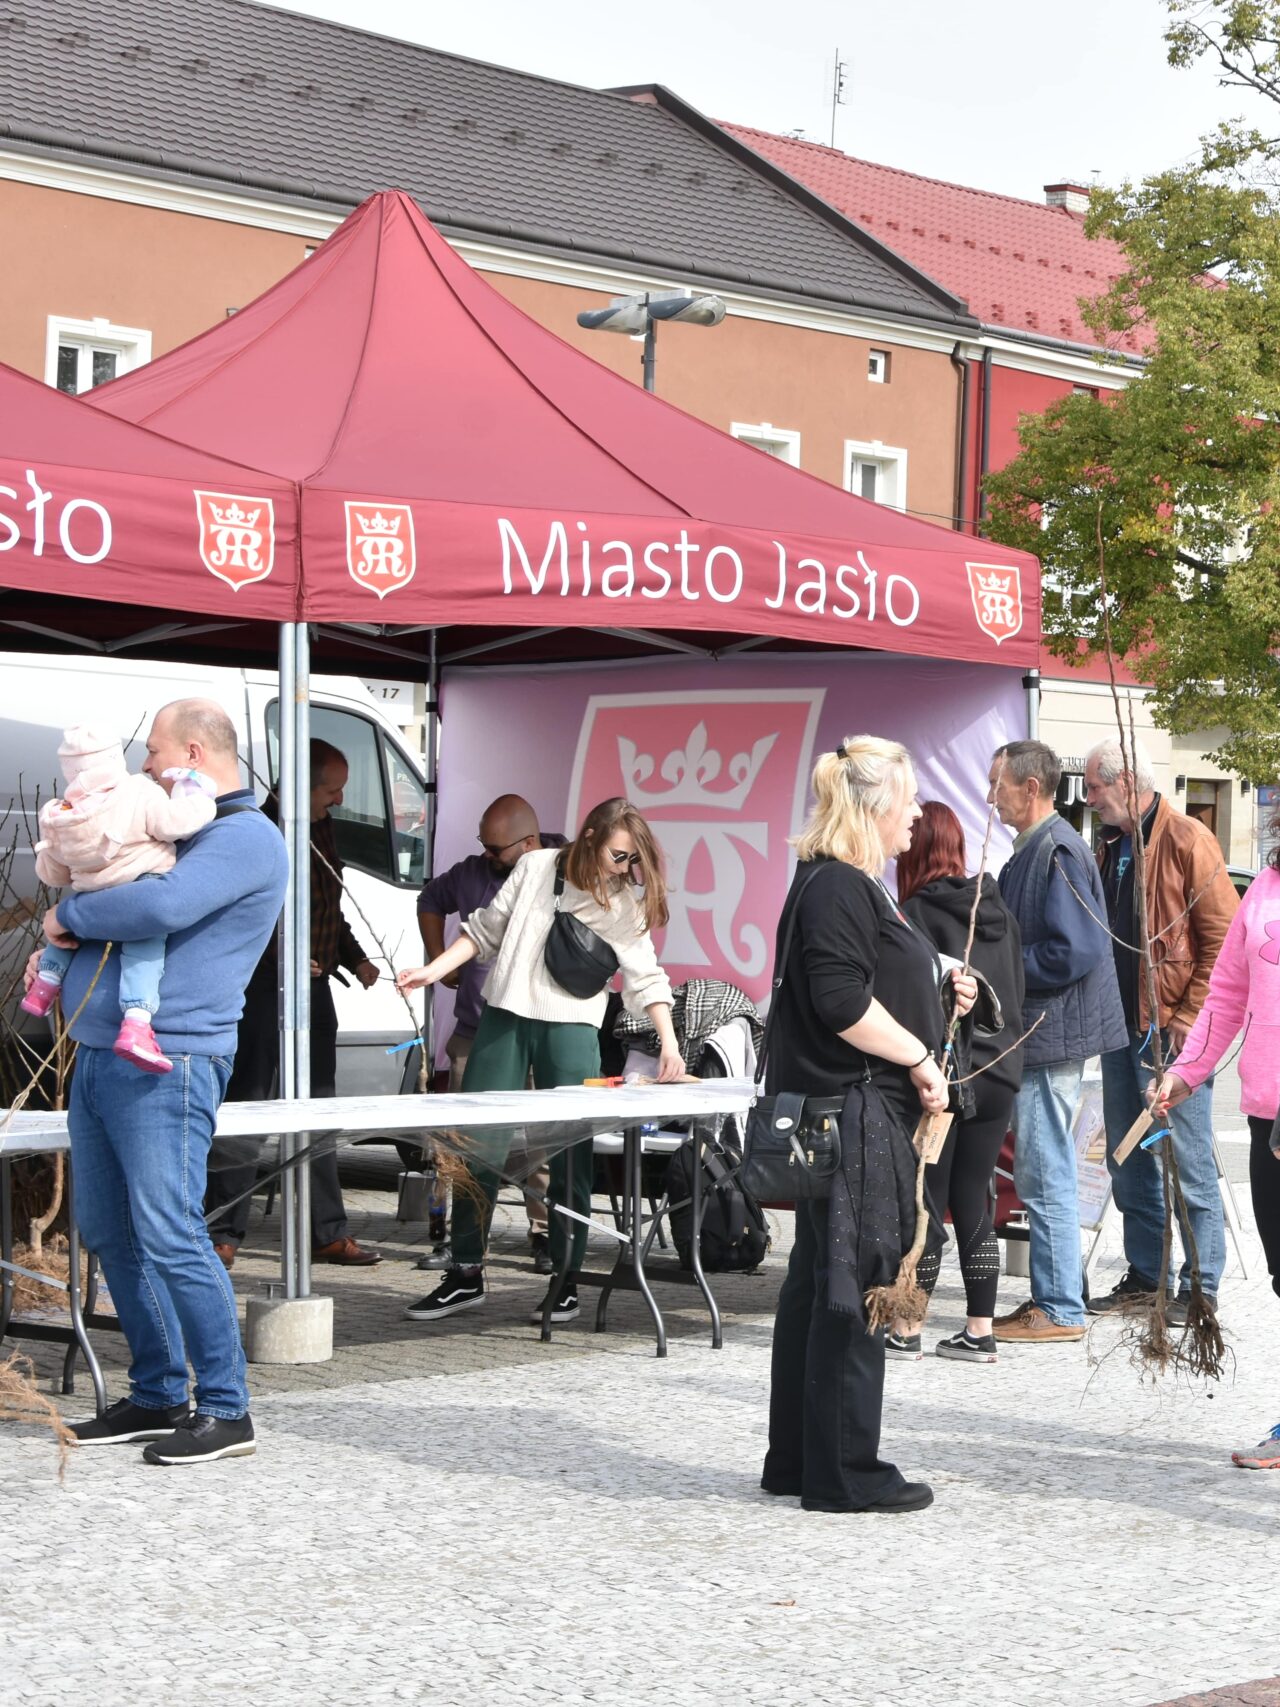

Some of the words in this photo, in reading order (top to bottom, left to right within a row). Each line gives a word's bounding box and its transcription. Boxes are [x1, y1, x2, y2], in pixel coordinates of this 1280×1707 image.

[497, 518, 743, 602] Miasto
[764, 541, 920, 626] Jasło
[382, 687, 400, 699] 17
